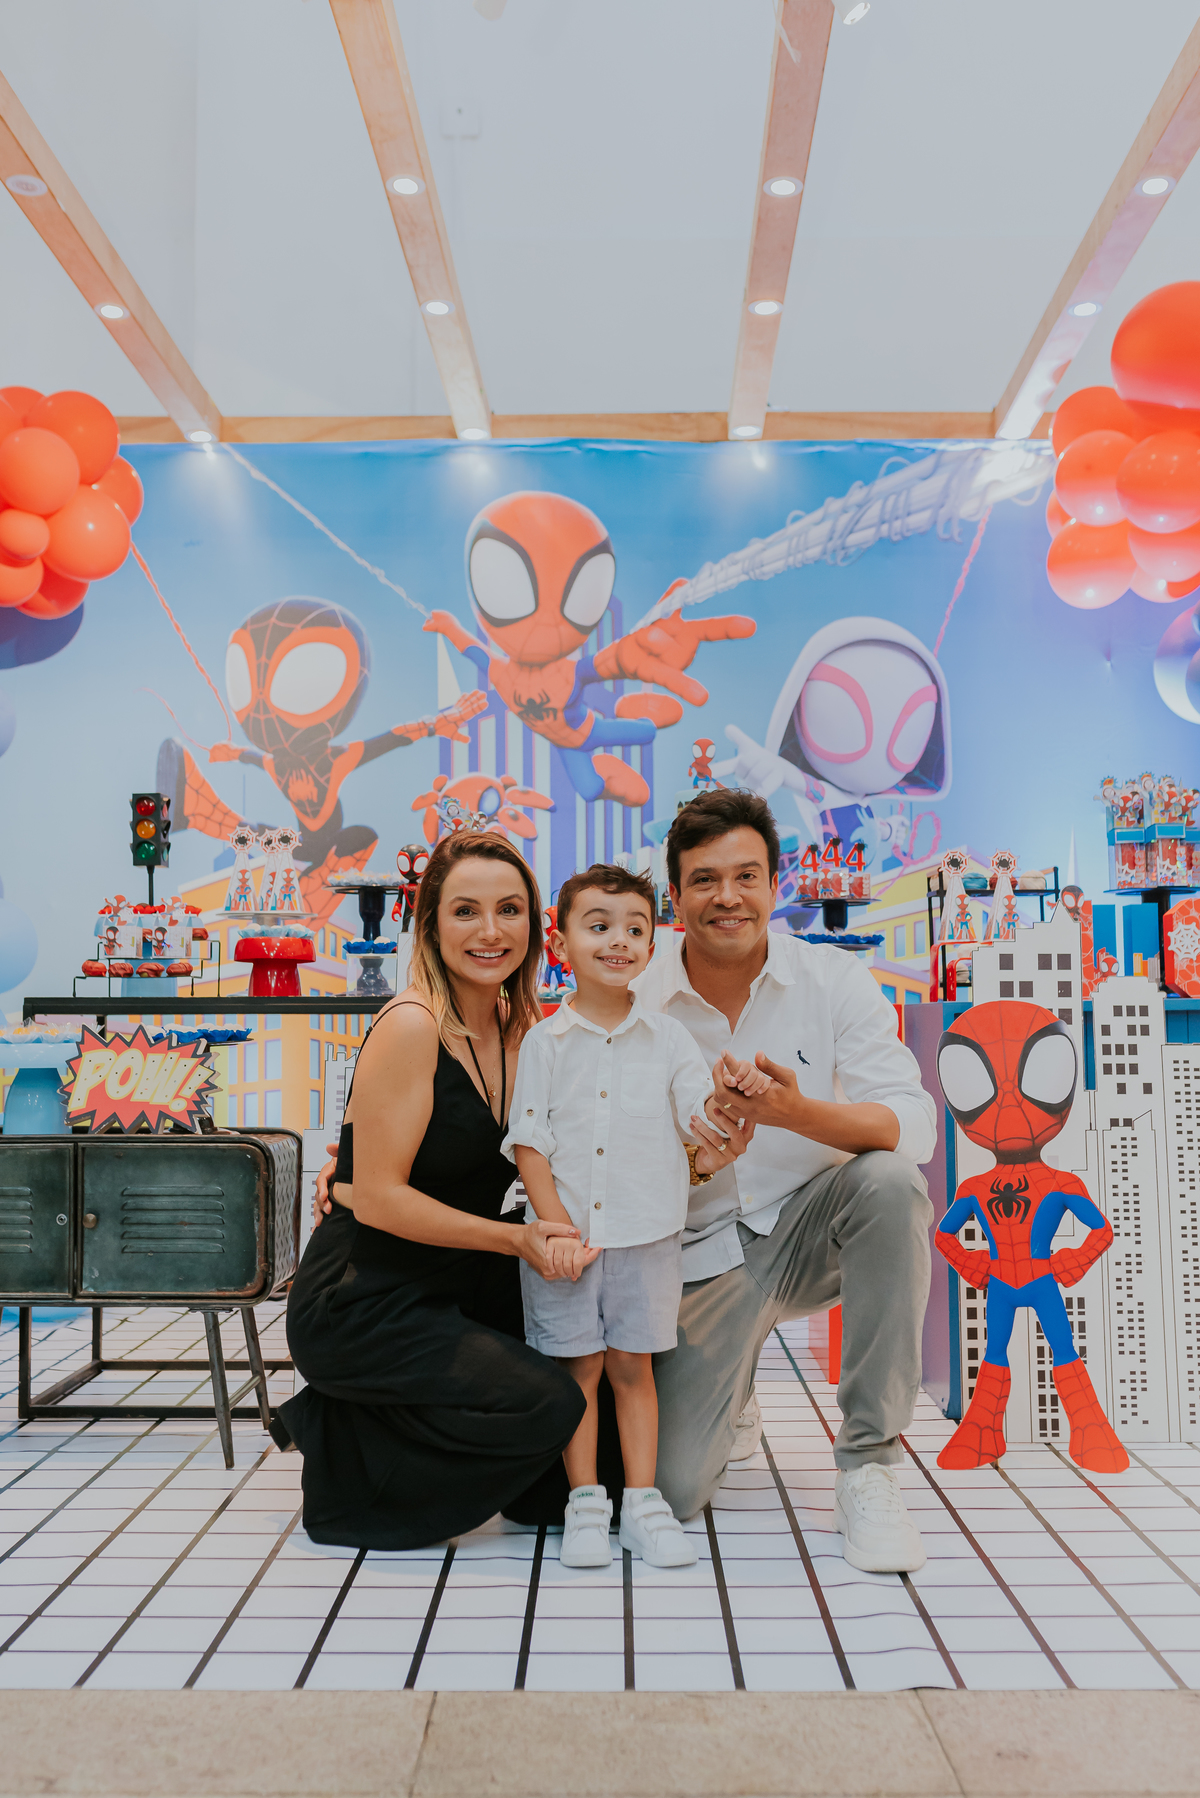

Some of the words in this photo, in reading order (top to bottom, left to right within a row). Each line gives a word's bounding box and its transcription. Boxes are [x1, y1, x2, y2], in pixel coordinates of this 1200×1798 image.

[800, 845, 820, 873] 4
[821, 838, 843, 868] 4
[845, 843, 866, 871] 4
[67, 1048, 214, 1112] POW!
